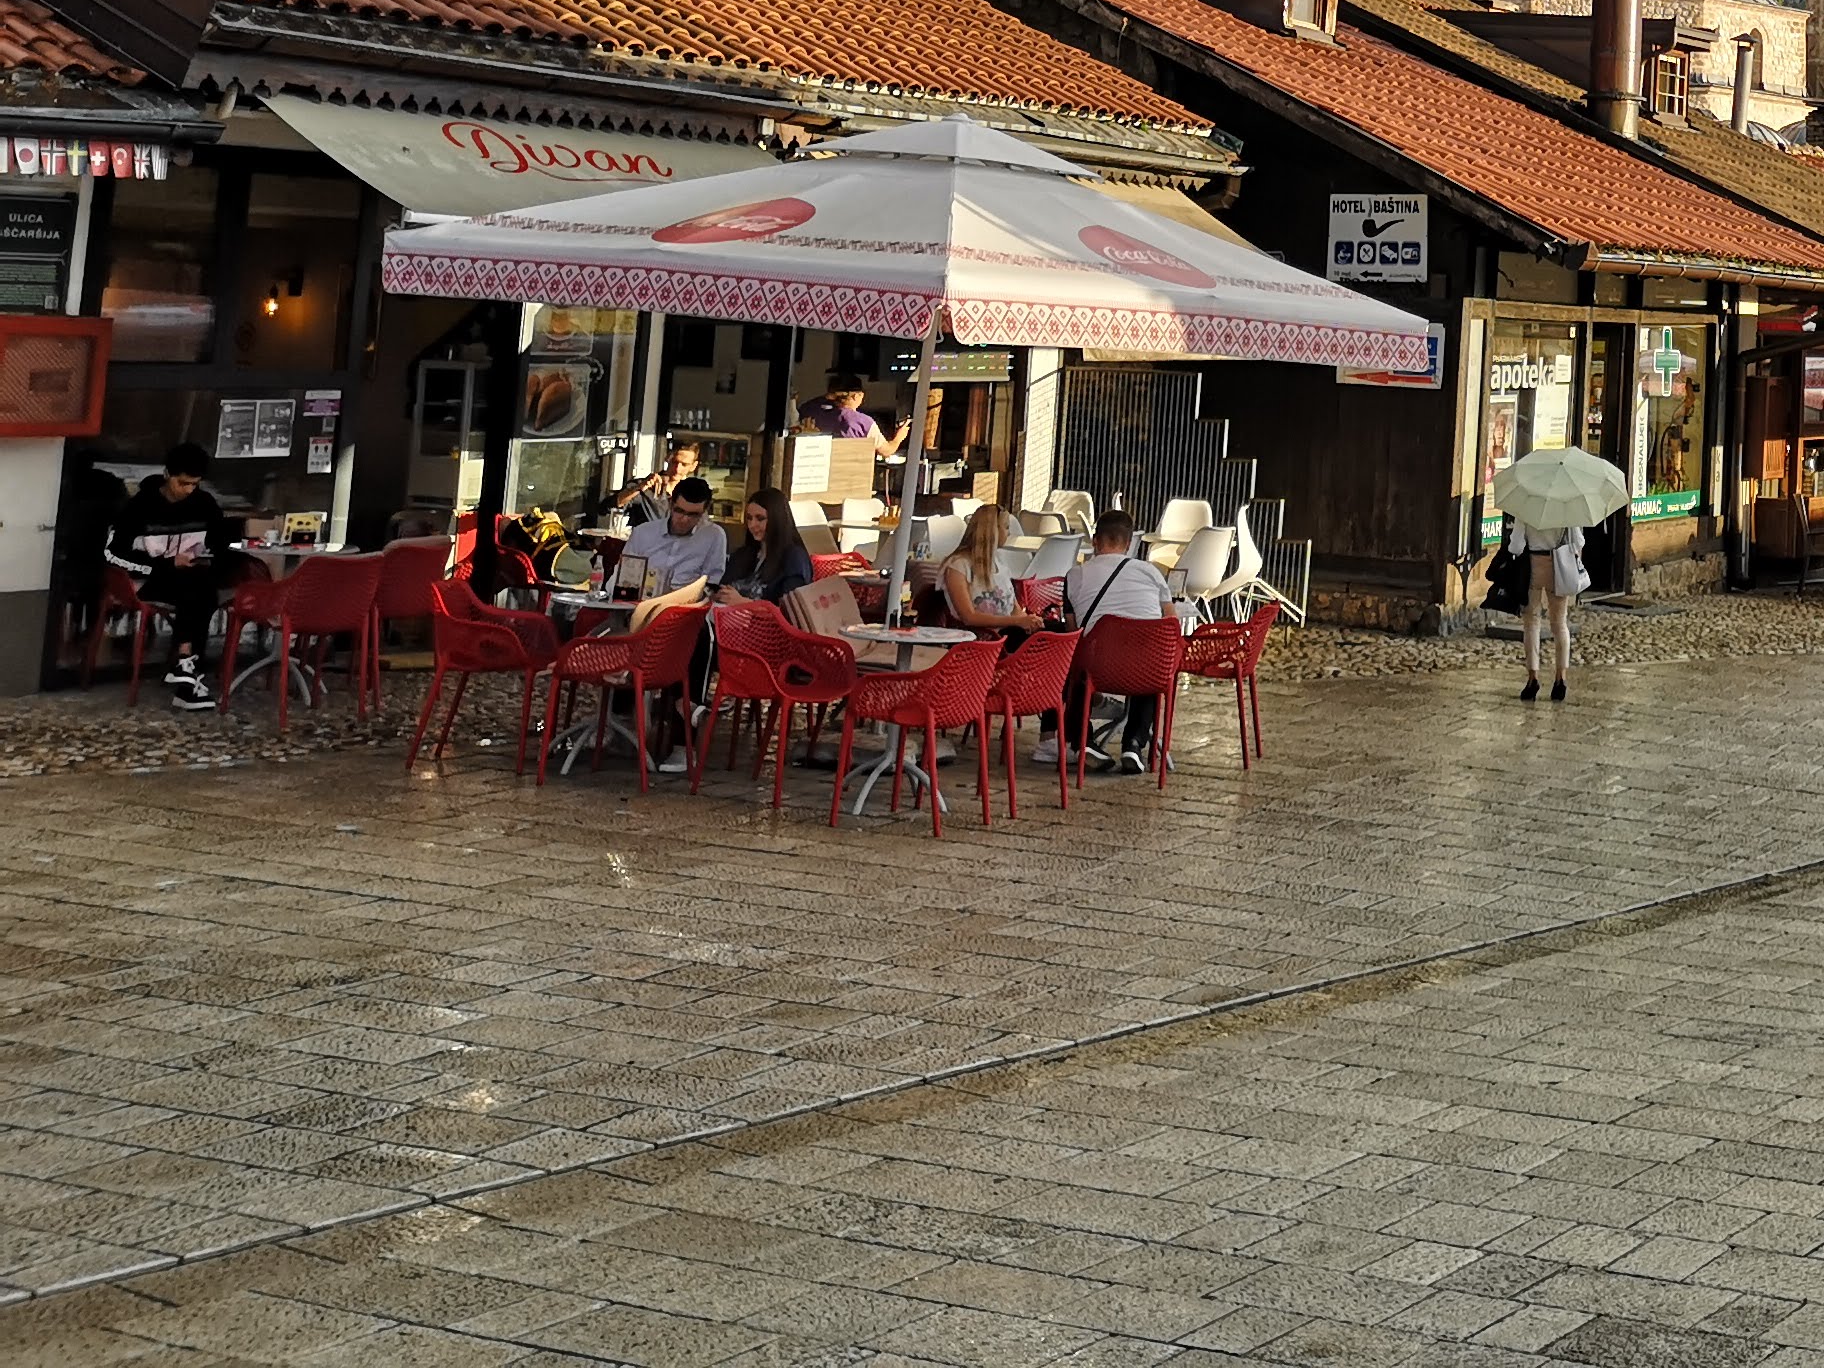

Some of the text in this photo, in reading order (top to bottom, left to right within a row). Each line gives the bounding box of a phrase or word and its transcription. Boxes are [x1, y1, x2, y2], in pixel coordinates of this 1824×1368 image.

[1332, 197, 1420, 214] HOTEL BAŠTINA
[9, 213, 43, 224] ULICA
[1490, 357, 1556, 396] apoteka
